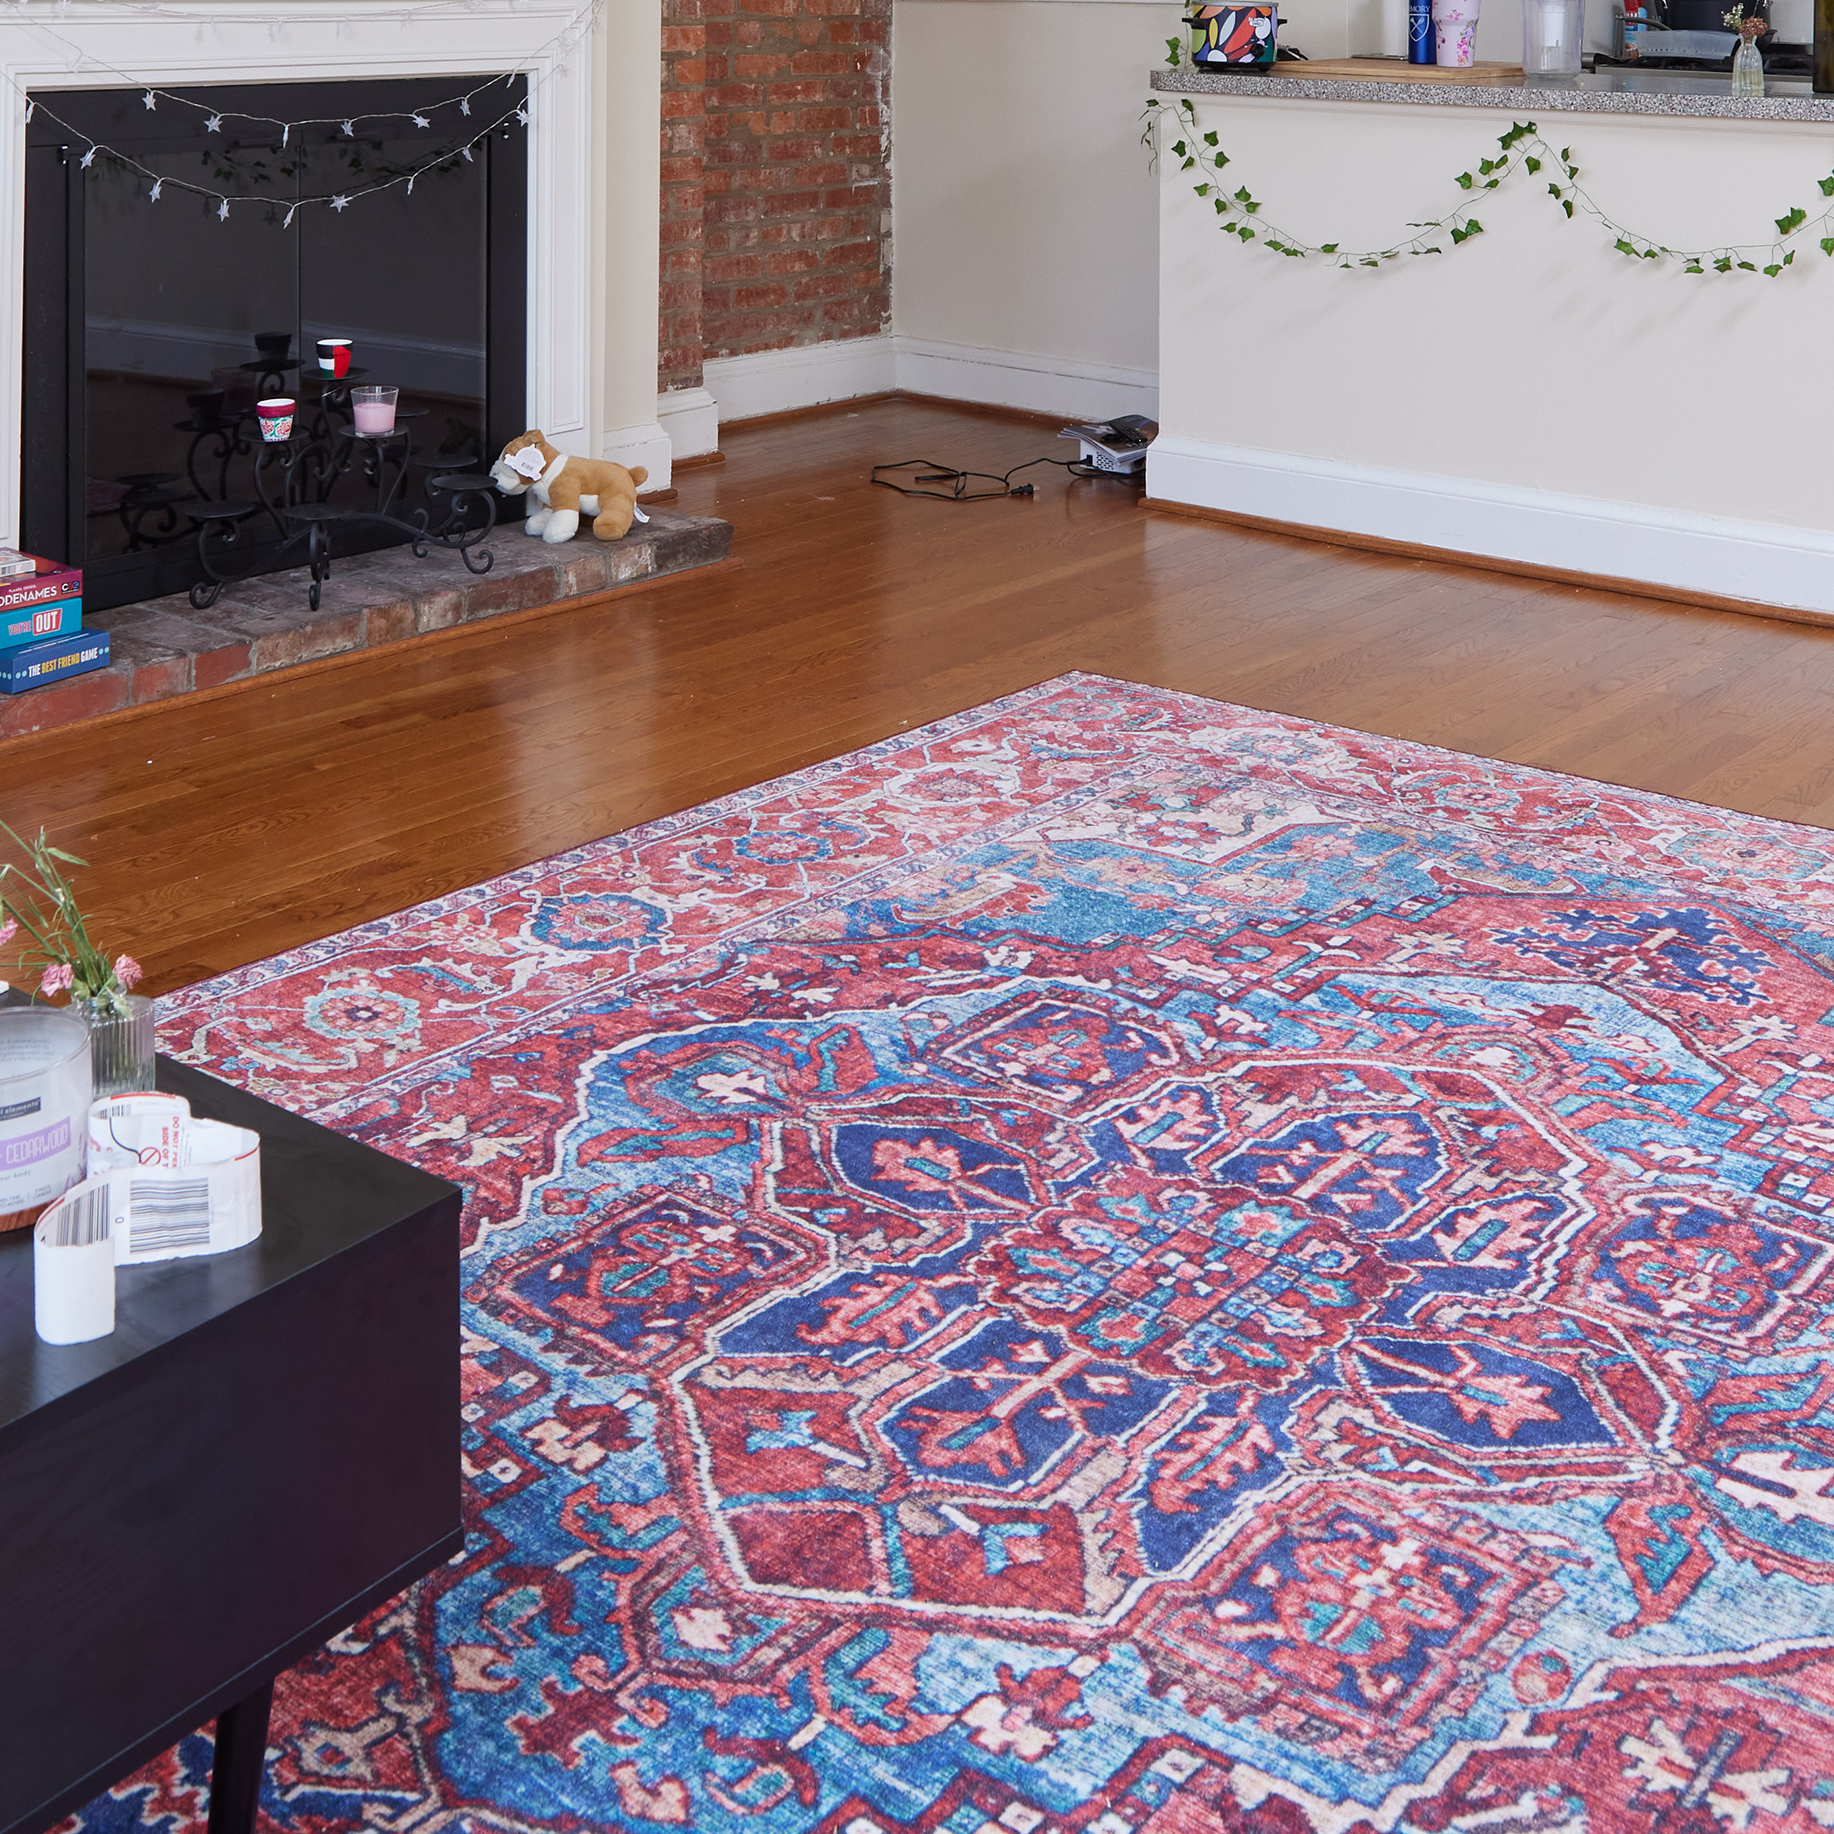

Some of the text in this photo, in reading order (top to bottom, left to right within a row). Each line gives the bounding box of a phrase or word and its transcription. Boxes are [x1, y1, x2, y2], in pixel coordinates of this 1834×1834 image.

[8, 611, 58, 636] YOU'RE OUT
[28, 647, 98, 677] THE BEST FRIEND GAME
[4, 1101, 39, 1114] elements
[173, 1116, 179, 1128] DO
[6, 1124, 68, 1164] CEDARWOOD
[13, 1170, 31, 1179] body
